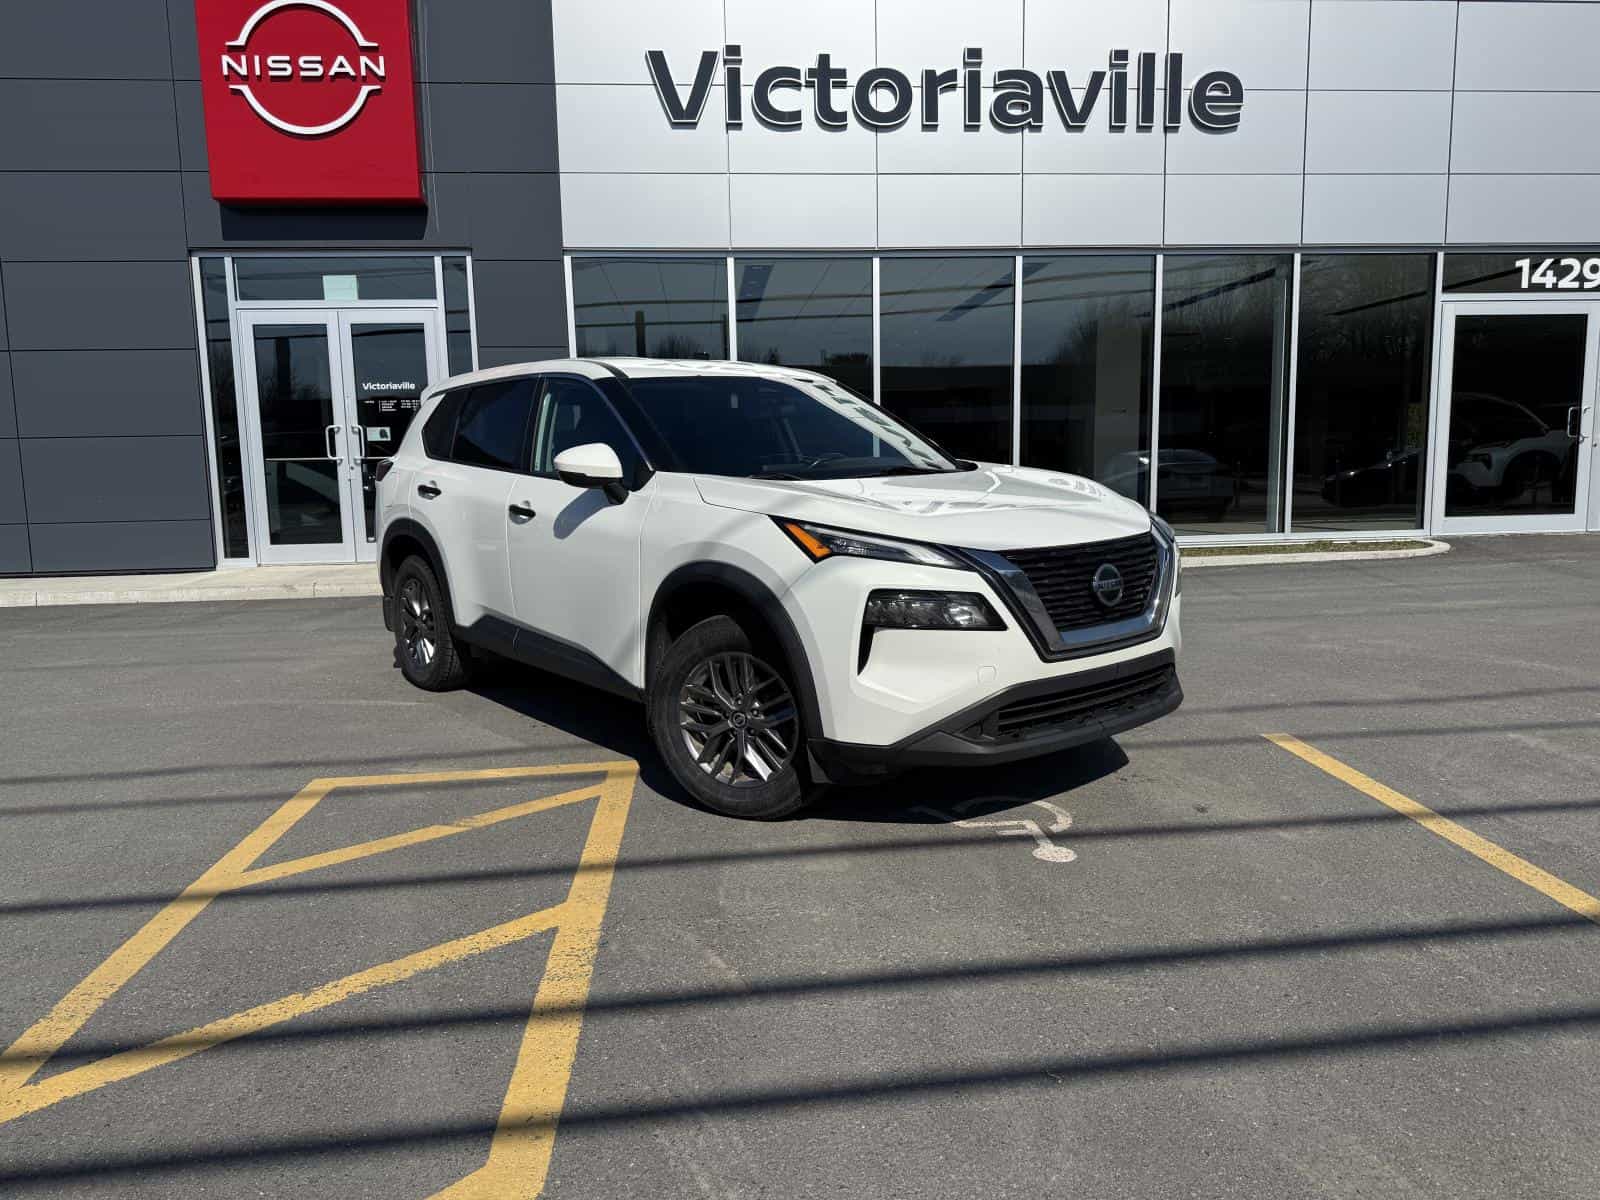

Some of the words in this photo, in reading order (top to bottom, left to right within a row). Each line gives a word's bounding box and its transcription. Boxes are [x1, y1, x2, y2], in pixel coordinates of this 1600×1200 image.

[221, 54, 386, 77] NISSAN
[645, 44, 1244, 131] Victoriaville
[1515, 257, 1600, 289] 1429
[362, 382, 416, 390] Victoriaville
